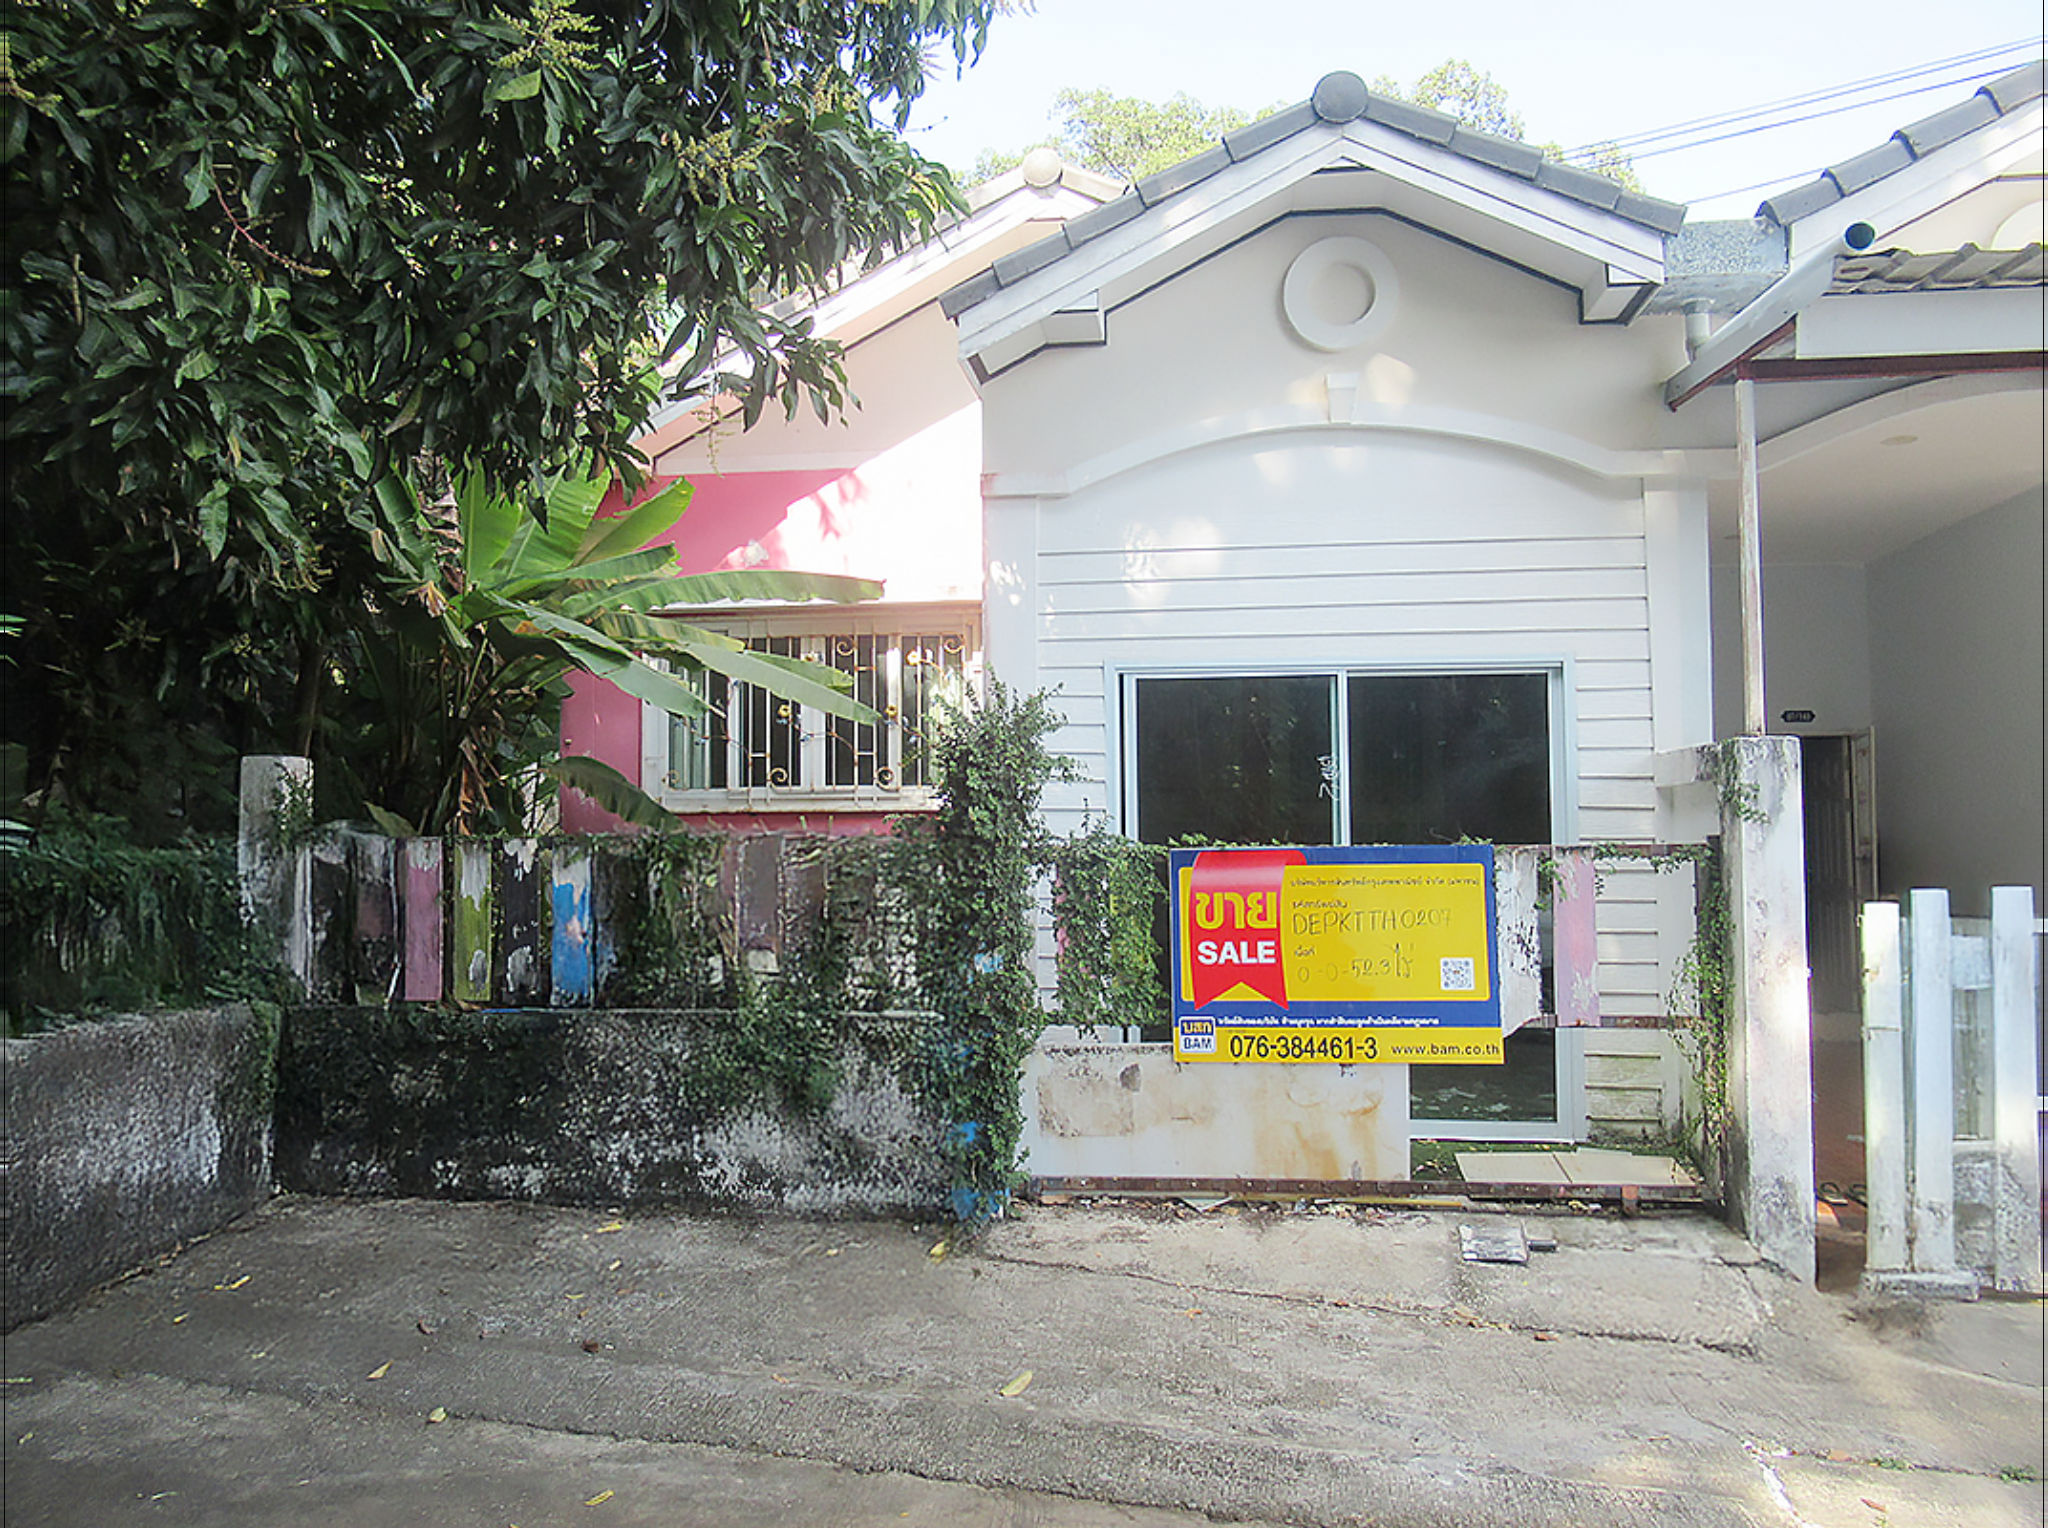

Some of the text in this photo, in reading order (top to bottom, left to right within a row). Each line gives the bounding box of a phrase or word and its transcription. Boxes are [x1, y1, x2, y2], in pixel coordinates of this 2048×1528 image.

[1195, 891, 1277, 930] ขาย
[1197, 940, 1277, 965] SALE
[1183, 1036, 1212, 1050] BAM
[1229, 1034, 1378, 1060] 076-384461-3
[1390, 1042, 1500, 1056] www.bam.co.th
